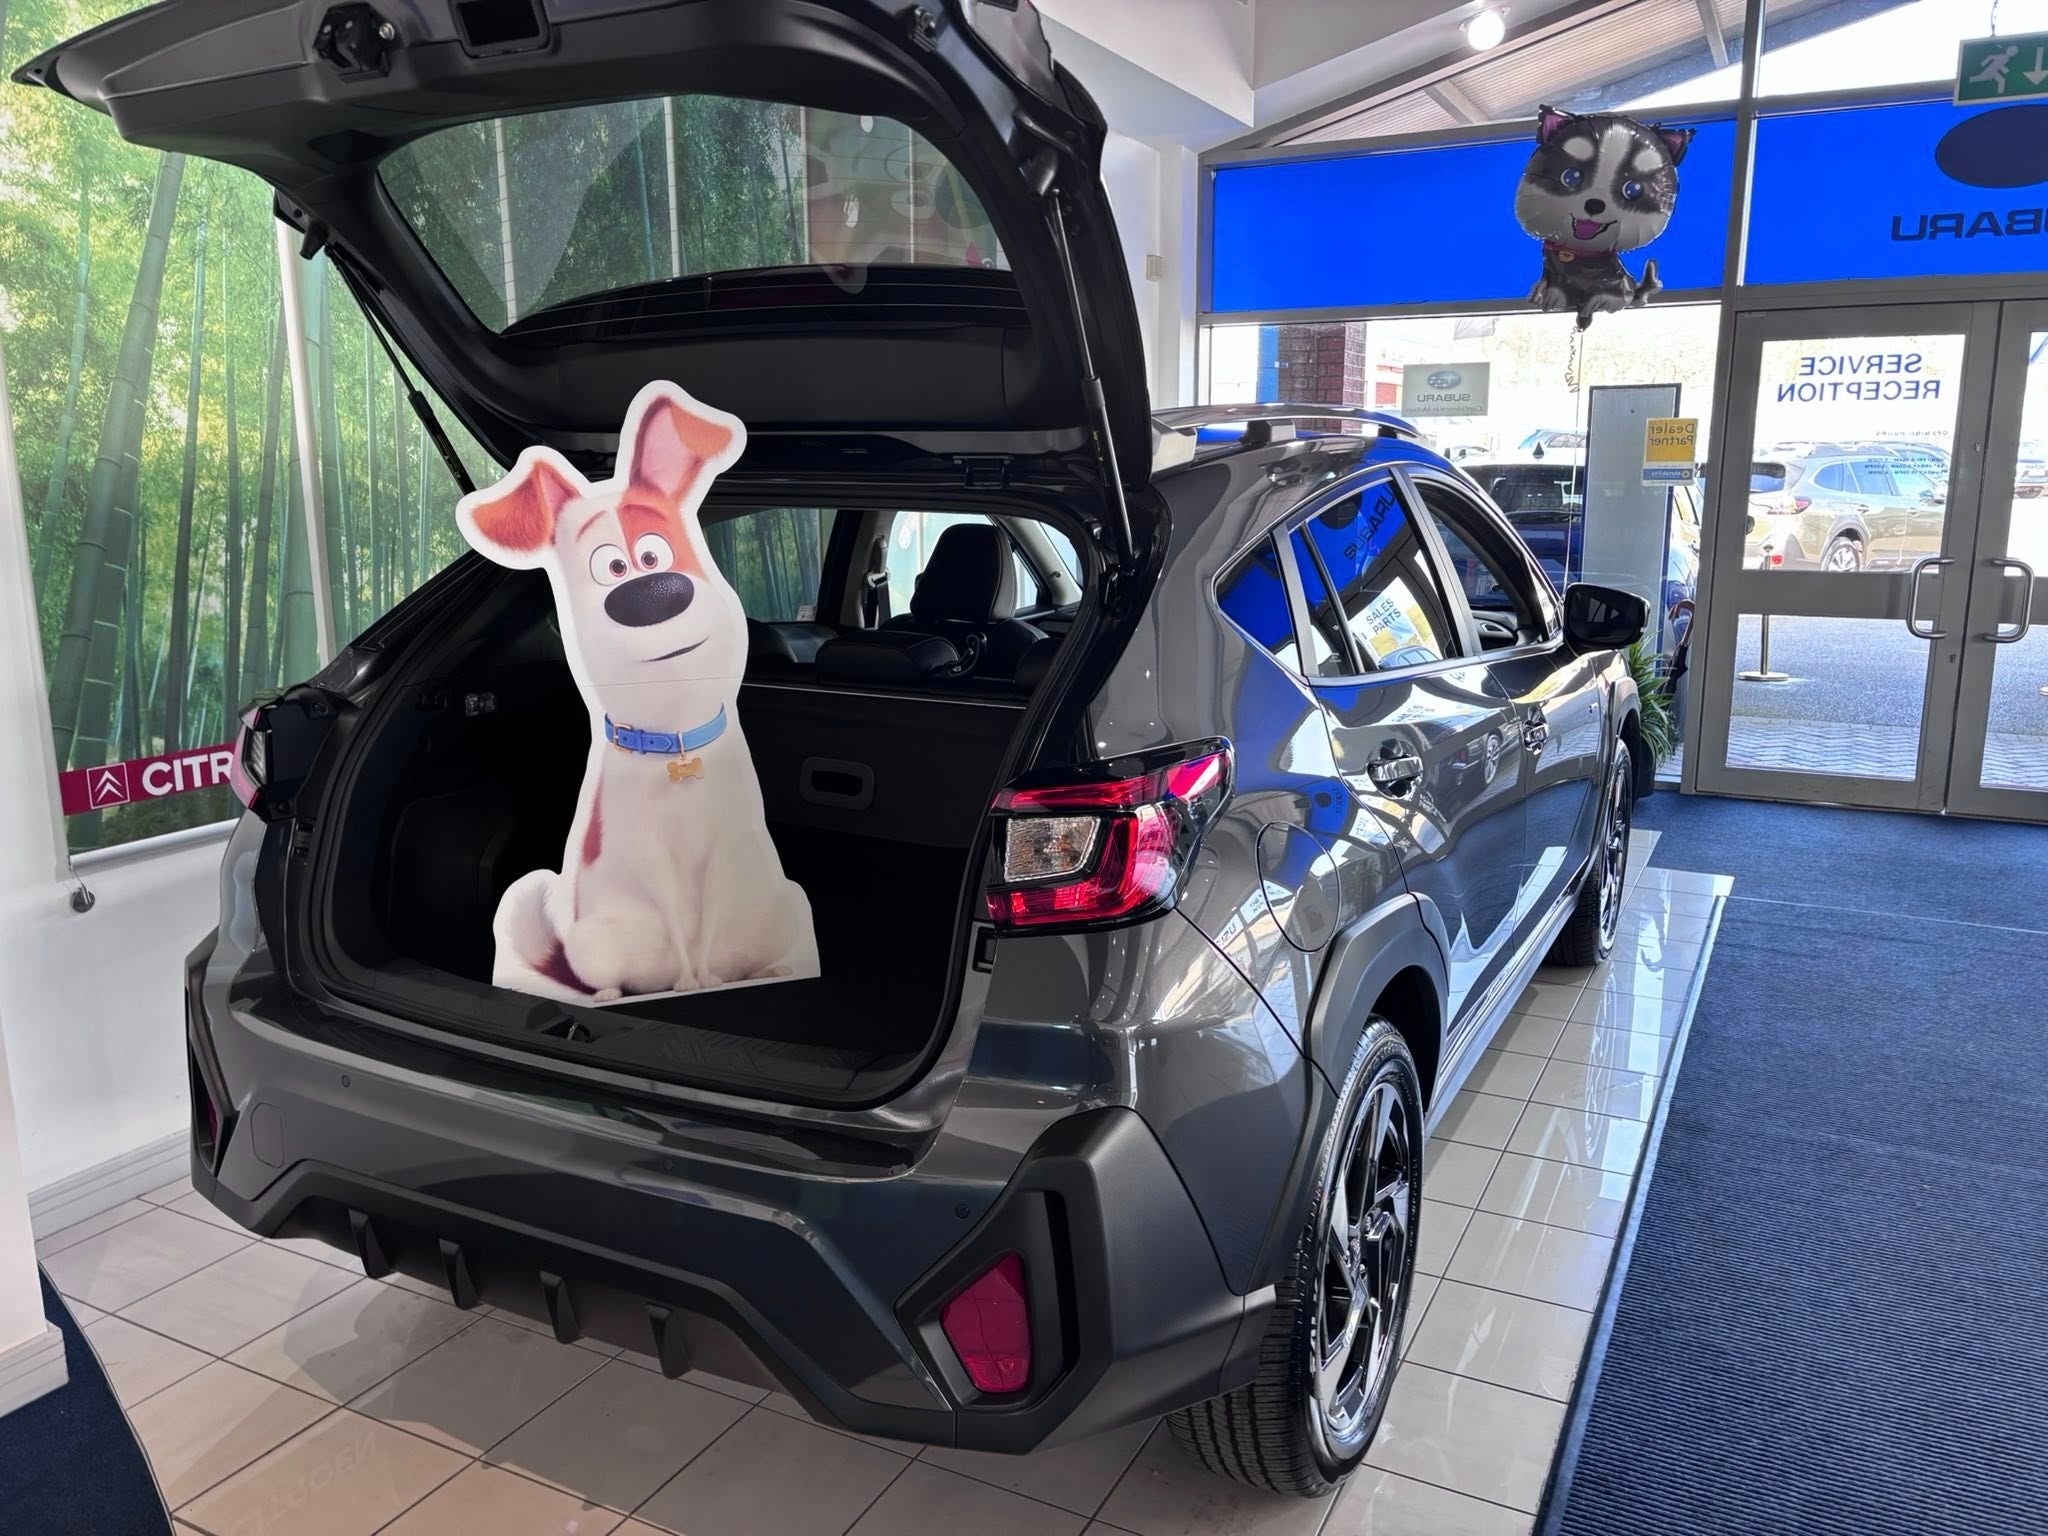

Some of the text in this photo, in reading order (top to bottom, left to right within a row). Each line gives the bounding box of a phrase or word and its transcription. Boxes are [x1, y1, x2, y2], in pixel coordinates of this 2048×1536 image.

[1344, 485, 1397, 560] SUBARU
[1366, 598, 1395, 625] SALES
[1374, 608, 1402, 635] PARTS
[142, 752, 234, 796] CITR
